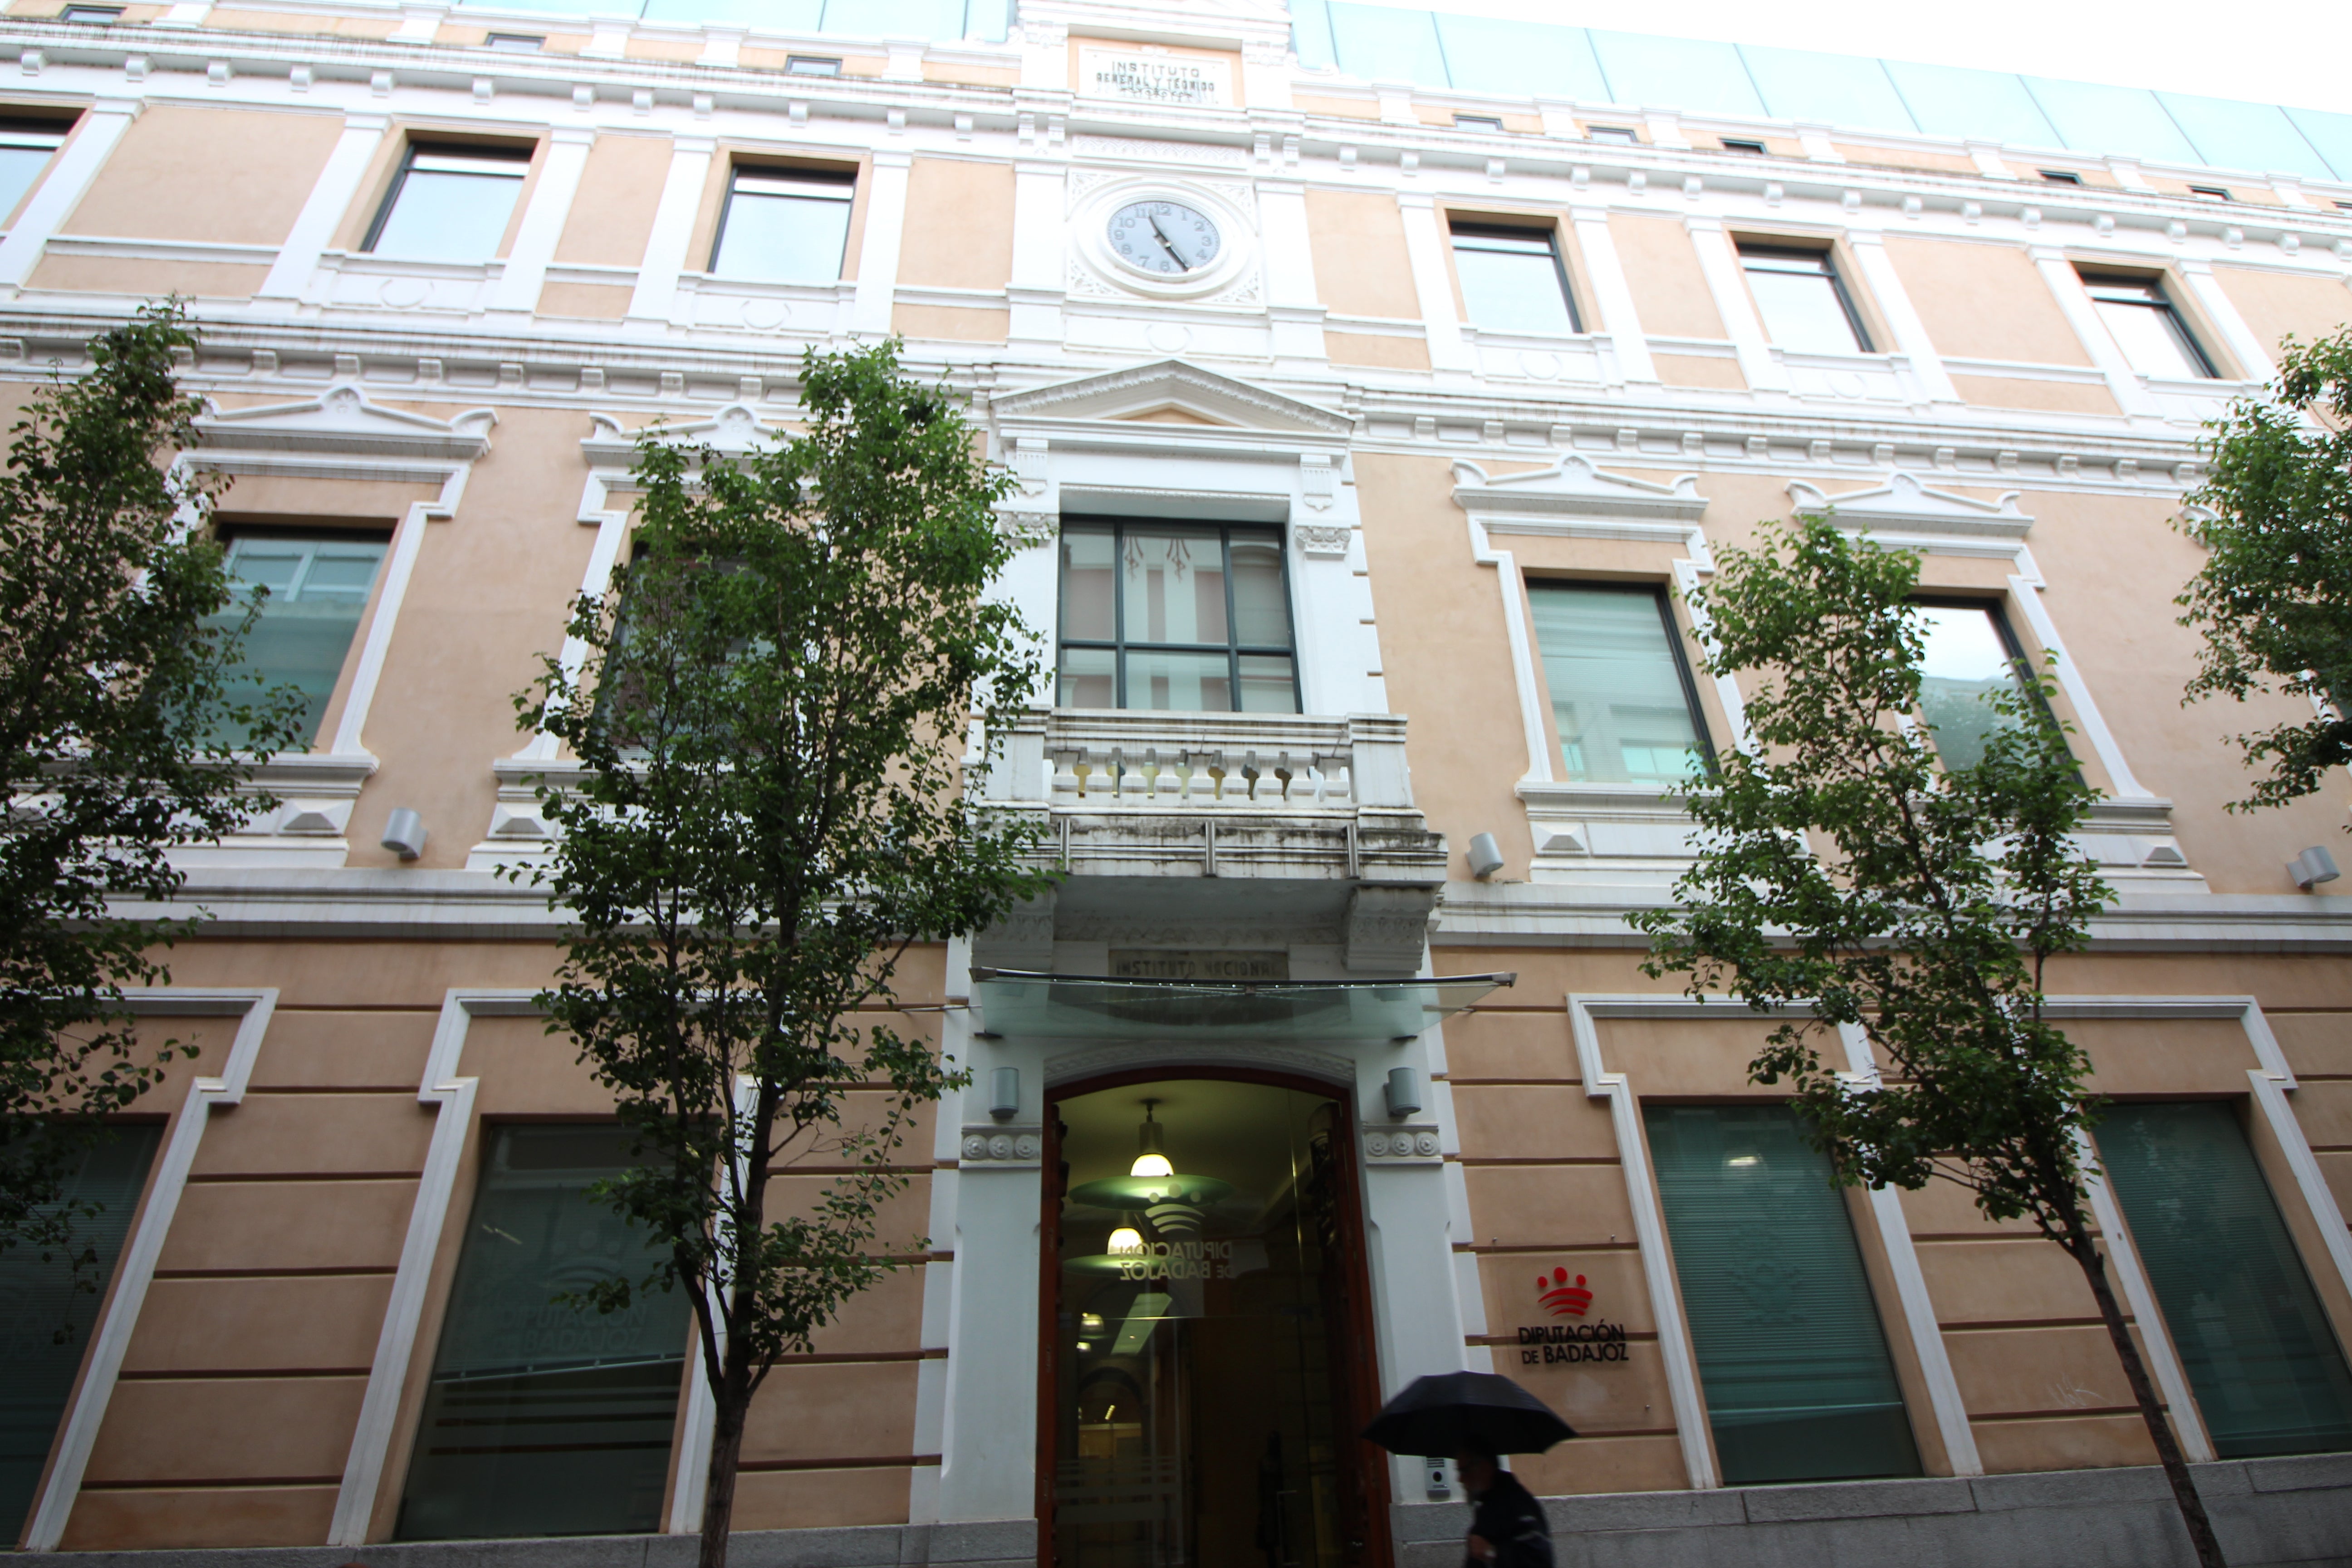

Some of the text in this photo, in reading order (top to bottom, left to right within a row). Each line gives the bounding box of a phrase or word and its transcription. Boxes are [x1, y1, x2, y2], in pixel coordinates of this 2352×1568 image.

[1112, 61, 1199, 78] INSTITUTO
[1096, 73, 1149, 87] GENERAL
[1135, 207, 1147, 218] 11
[1155, 204, 1171, 216] 12
[1181, 211, 1187, 221] 1
[1118, 217, 1135, 228] 10
[1194, 221, 1205, 232] 2
[1114, 229, 1124, 240] 9
[1202, 236, 1211, 247] 3
[1121, 245, 1132, 255] 8
[1139, 255, 1149, 267] 7
[1160, 261, 1170, 272] 6
[1116, 960, 1279, 976] INSTITUTO NACIONAL
[1518, 1318, 1626, 1344] DIPUTACIÓN
[524, 1327, 642, 1353] BADAJOZ
[1521, 1343, 1629, 1364] DE BADAJOZ
